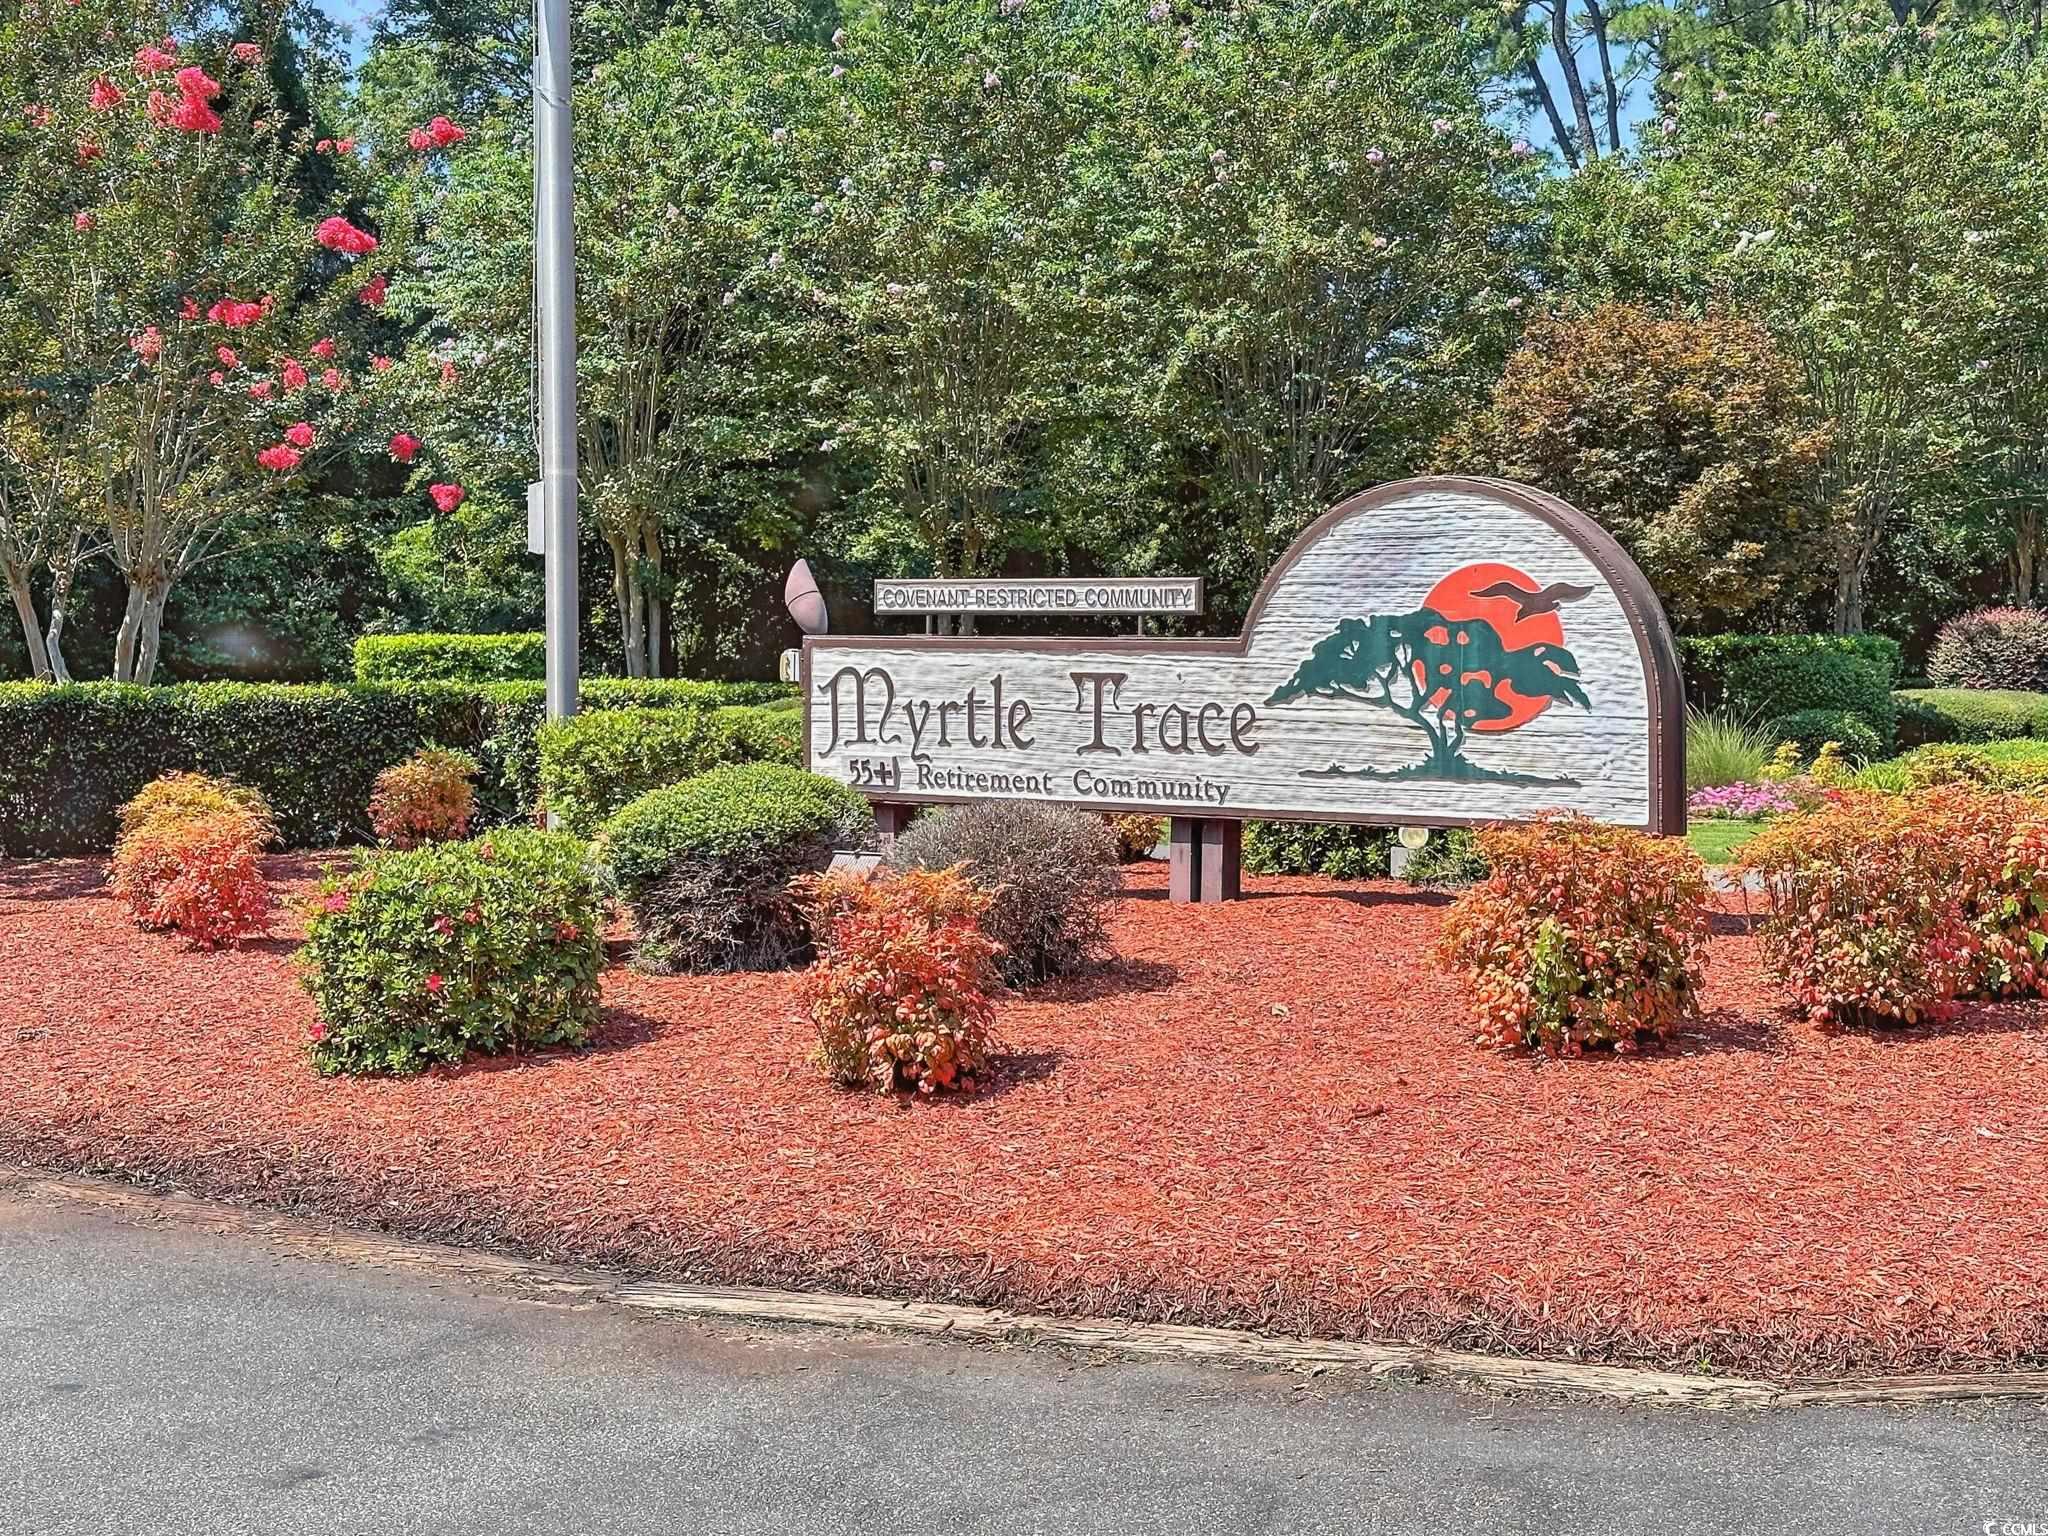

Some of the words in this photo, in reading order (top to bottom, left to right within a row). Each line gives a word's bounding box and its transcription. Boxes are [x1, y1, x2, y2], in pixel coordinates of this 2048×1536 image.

[882, 588, 969, 608] COVENANT
[975, 588, 1077, 608] RESTRICTED
[1084, 588, 1193, 608] COMMUNITY
[817, 666, 1036, 763] Myrtle
[1069, 672, 1260, 757] Trace
[849, 758, 893, 785] 55+
[916, 763, 1052, 794] Retirement
[1073, 769, 1231, 805] Community
